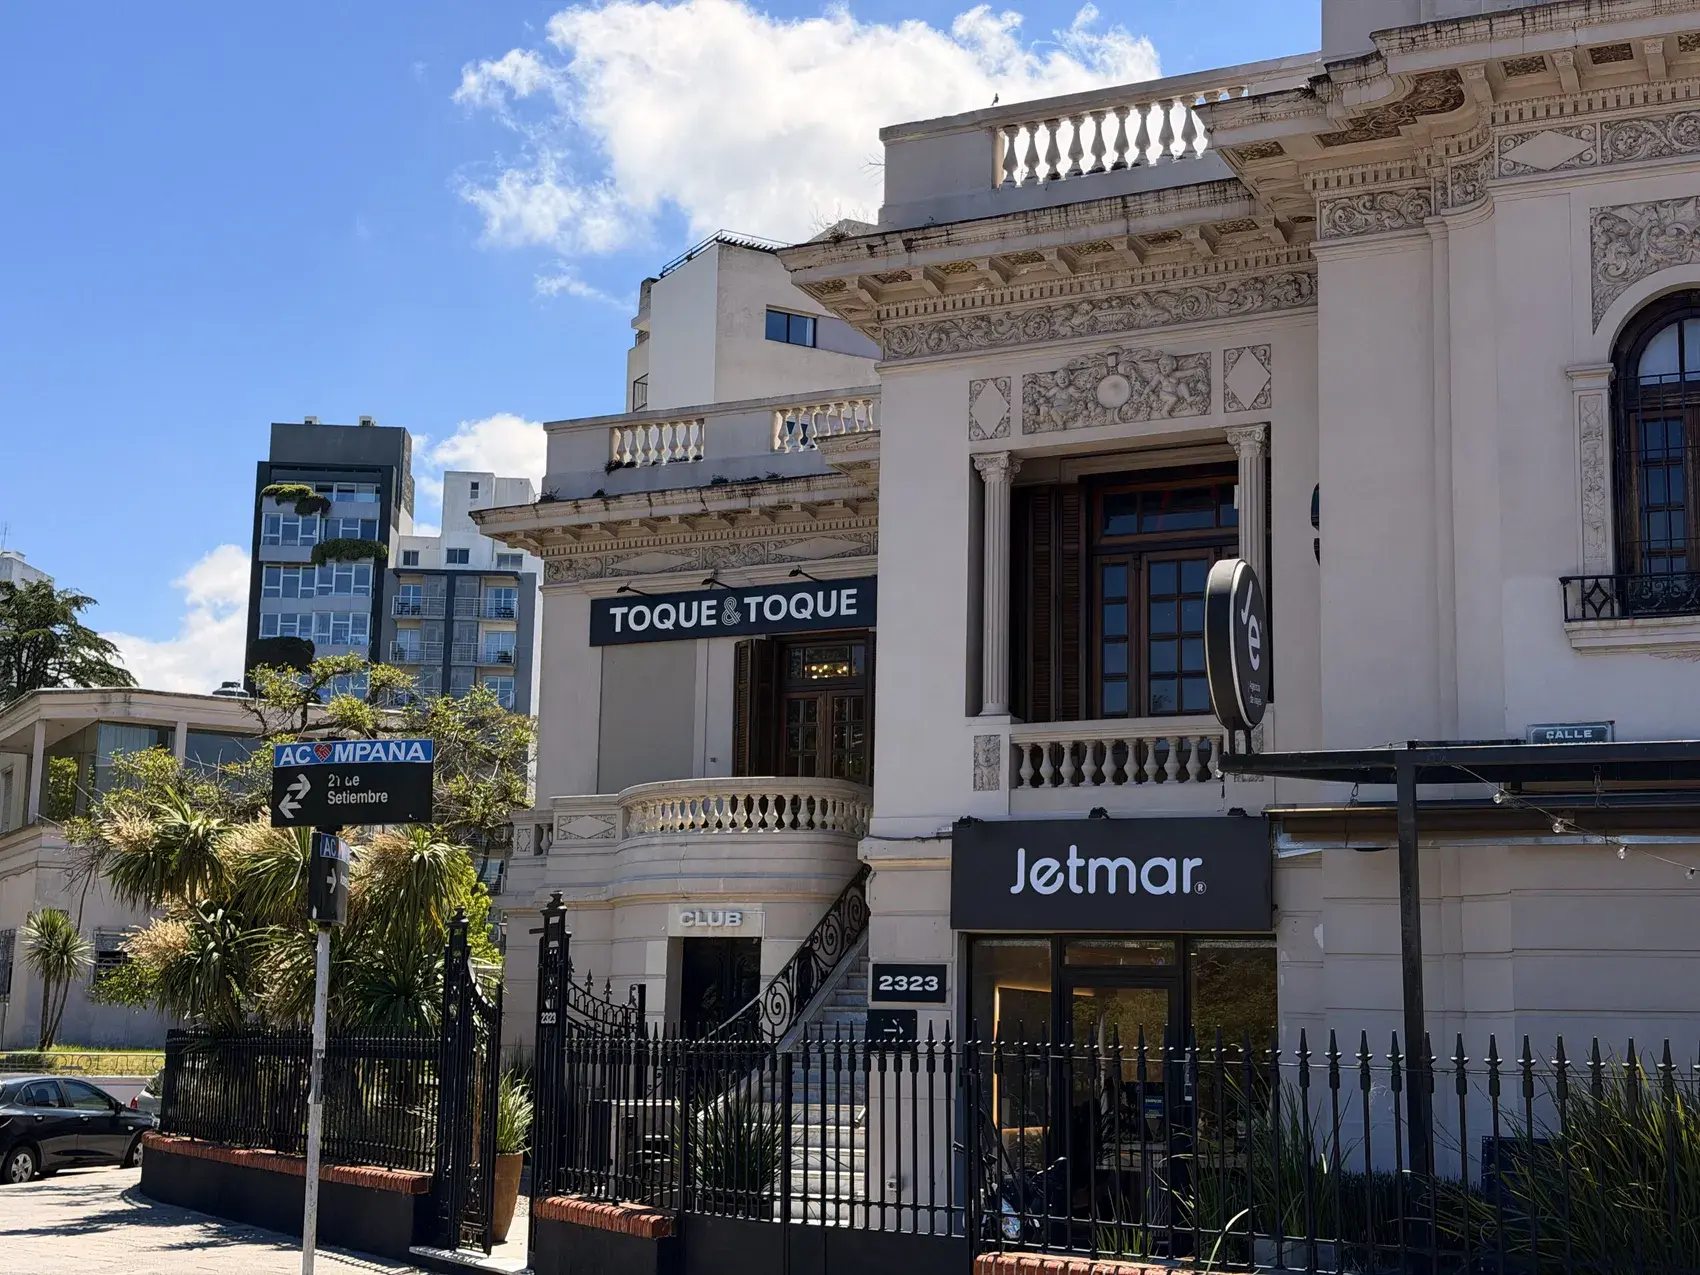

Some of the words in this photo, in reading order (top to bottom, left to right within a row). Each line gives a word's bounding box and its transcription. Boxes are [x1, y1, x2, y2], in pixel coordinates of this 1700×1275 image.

[609, 600, 717, 633] TOQUE
[721, 596, 742, 626] &
[743, 588, 858, 622] TOQUE
[1545, 729, 1592, 739] CALLE
[327, 789, 389, 805] Setiembre
[679, 911, 743, 928] CLUB
[878, 975, 939, 991] 2323
[540, 1012, 557, 1024] 2323
